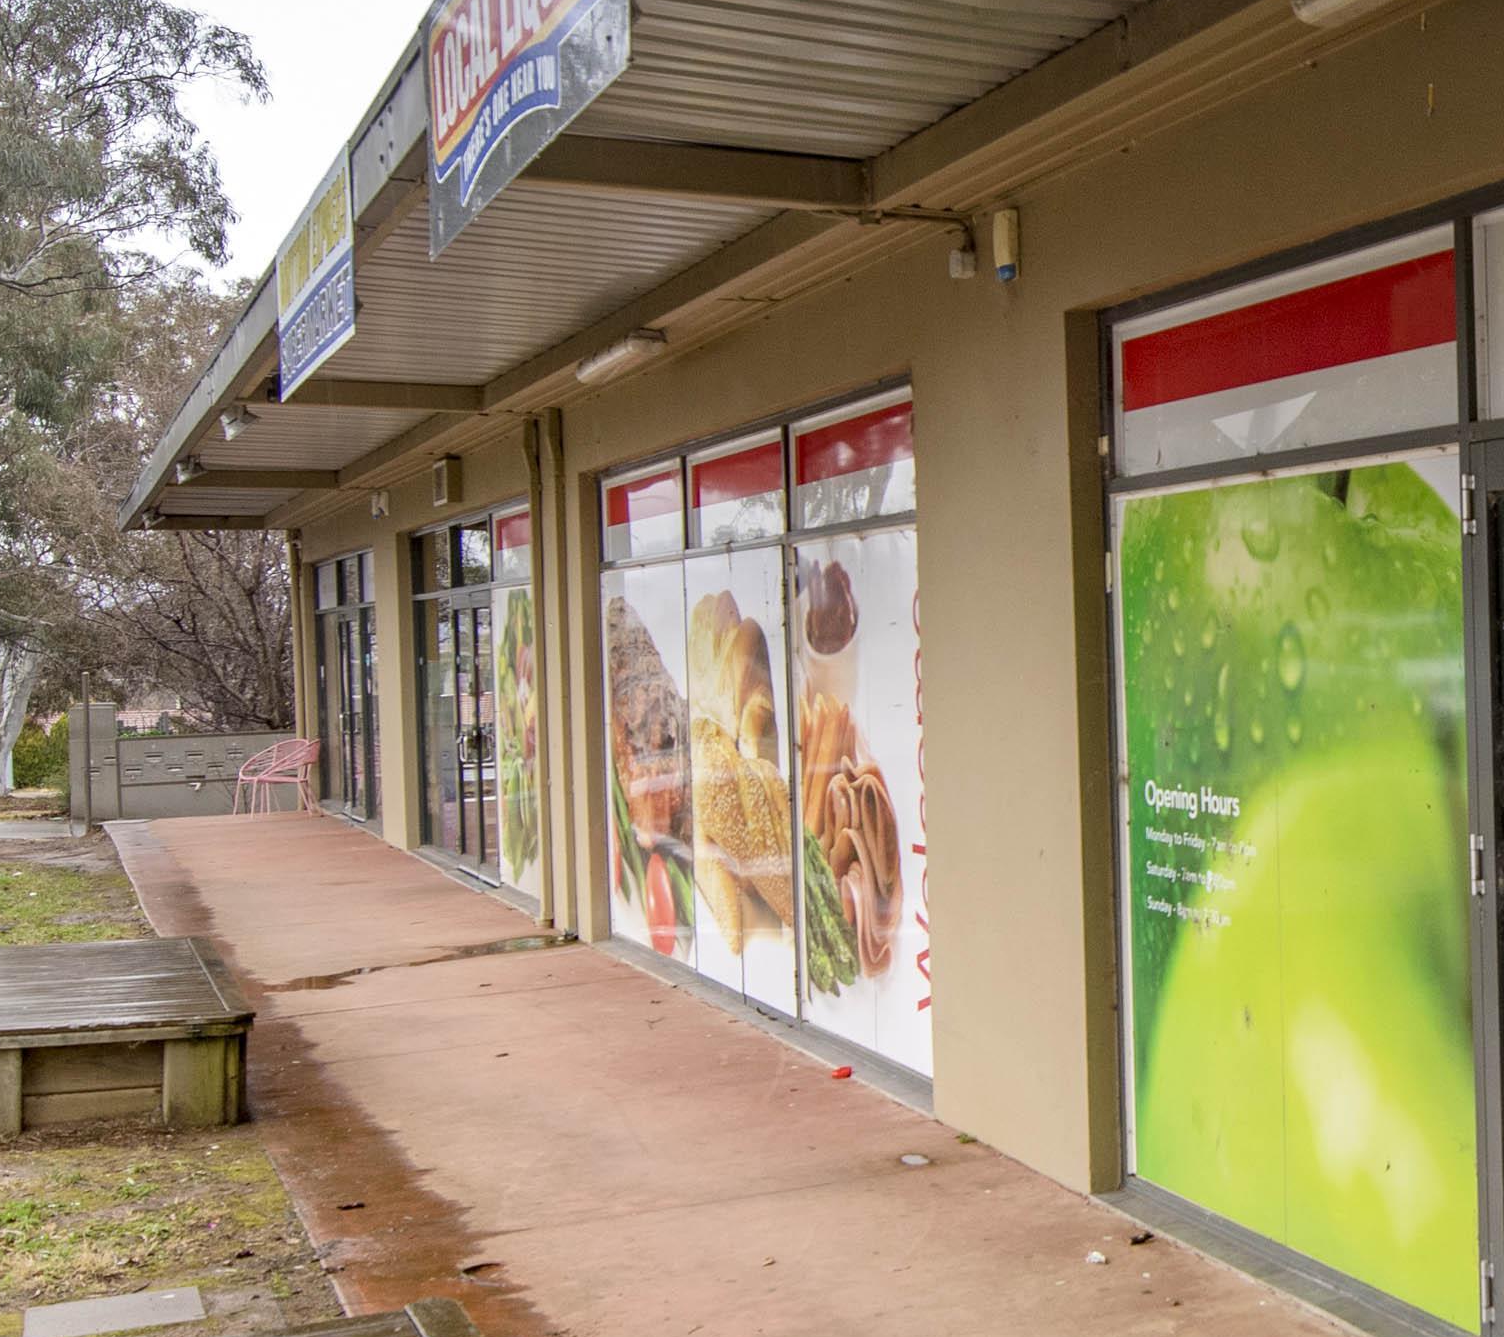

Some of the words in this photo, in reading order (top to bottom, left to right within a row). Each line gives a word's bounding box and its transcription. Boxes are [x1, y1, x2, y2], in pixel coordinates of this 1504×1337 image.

[463, 103, 492, 182] THERE'S
[492, 79, 510, 126] ONE
[510, 59, 537, 106] NEAR
[536, 54, 556, 91] YOU
[281, 260, 352, 385] SUPERMARKET
[1144, 779, 1197, 819] Opening
[1200, 785, 1240, 817] Hours
[1145, 826, 1173, 847] Monday
[1174, 832, 1182, 845] to
[1183, 831, 1206, 853] Friday
[1145, 860, 1176, 883] Saturday
[1146, 895, 1172, 917] Sunday
